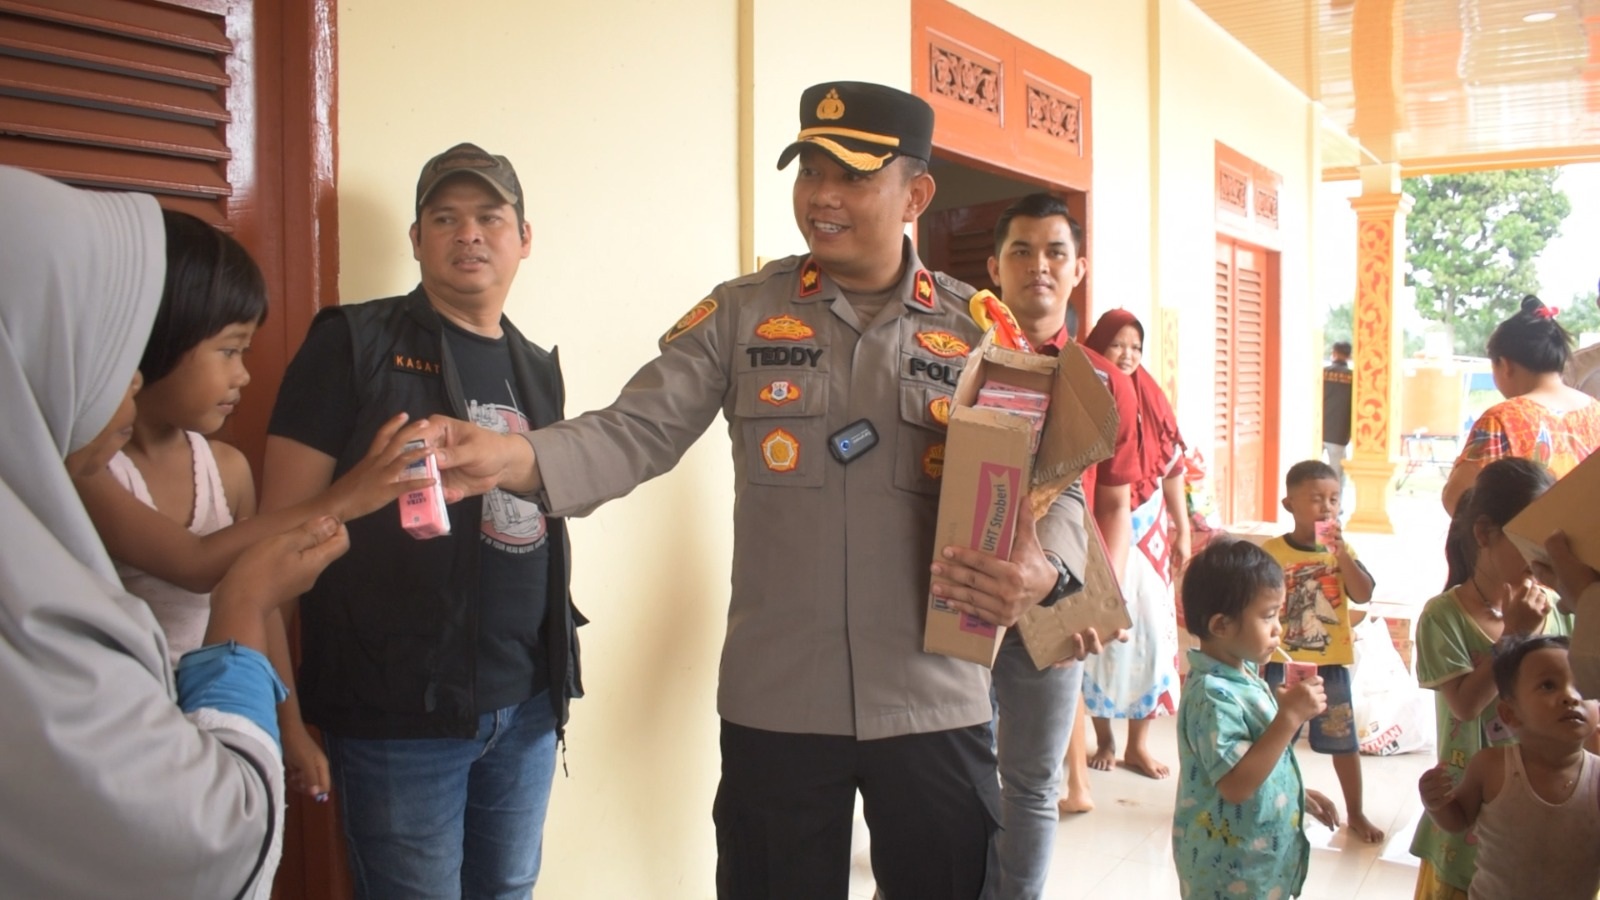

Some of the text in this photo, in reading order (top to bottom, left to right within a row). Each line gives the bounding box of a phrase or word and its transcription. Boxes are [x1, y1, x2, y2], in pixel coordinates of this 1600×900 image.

[396, 354, 441, 374] KASAT
[746, 346, 823, 367] TEDDY
[981, 483, 1007, 552] UHT Stroberi
